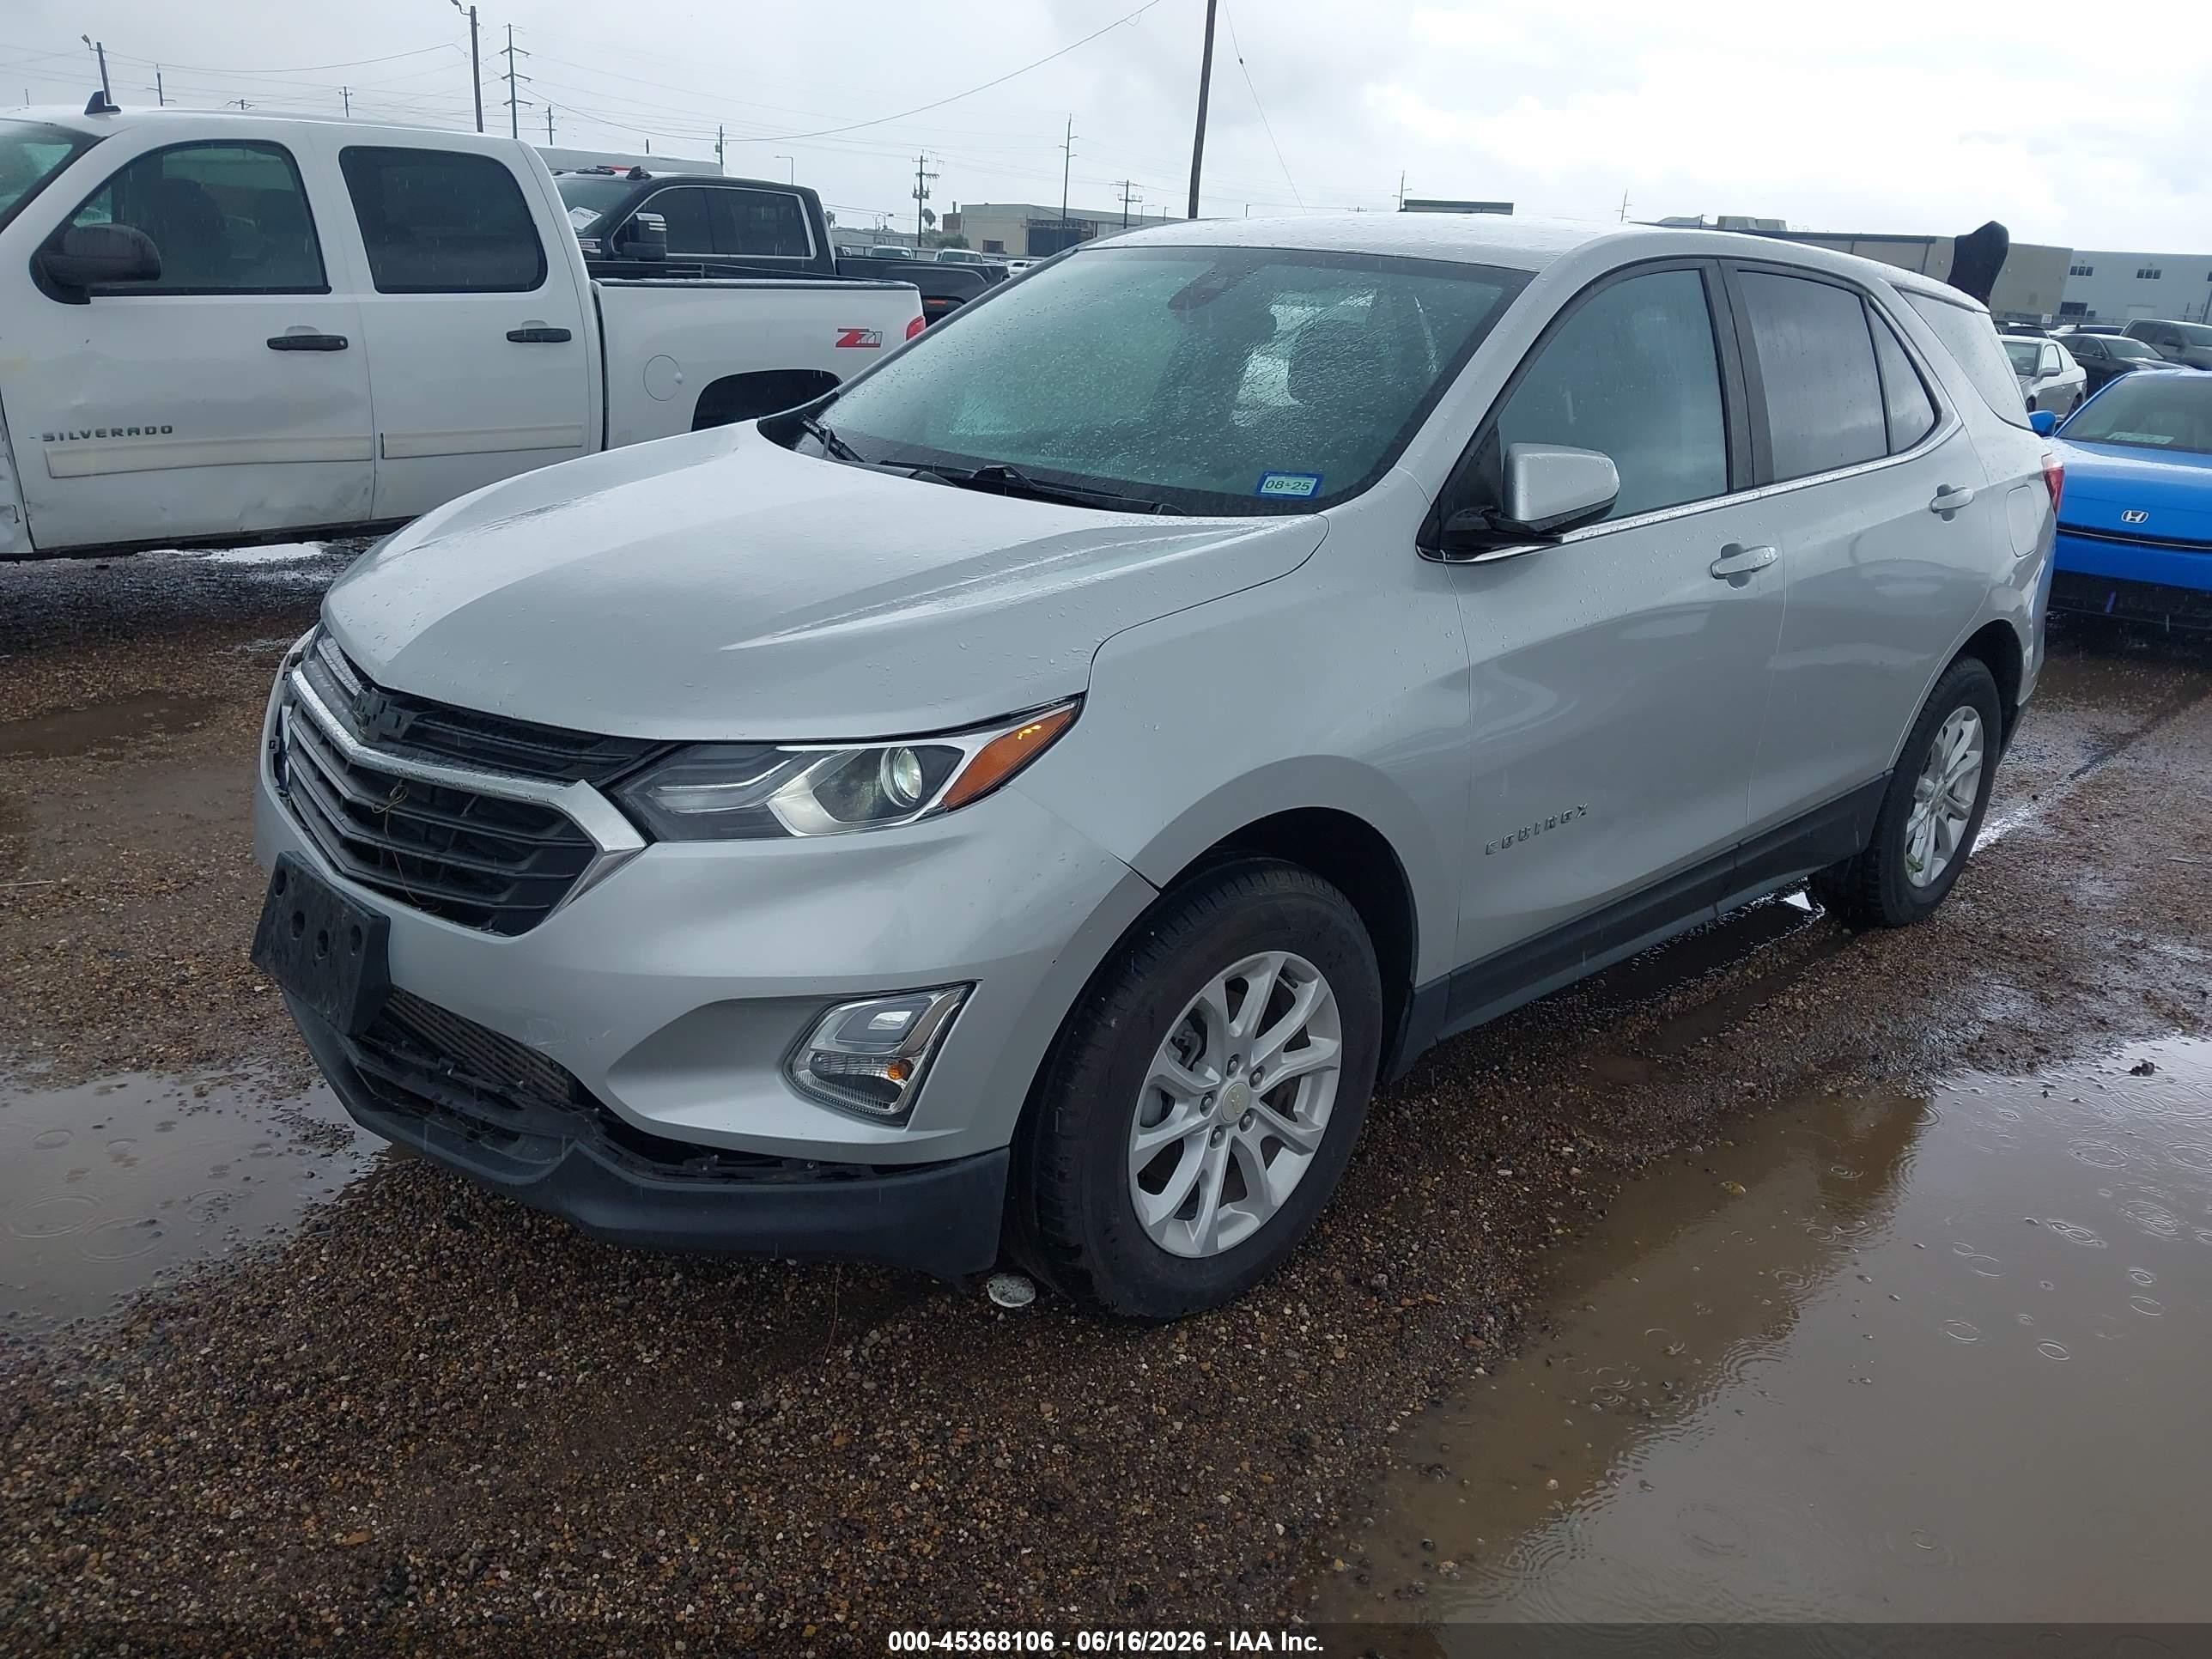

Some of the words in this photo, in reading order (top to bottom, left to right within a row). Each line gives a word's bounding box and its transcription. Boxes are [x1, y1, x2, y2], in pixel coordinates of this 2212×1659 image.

[835, 328, 883, 348] Z71
[42, 425, 173, 442] SILVERADO
[1485, 803, 1589, 855] EQUINOX
